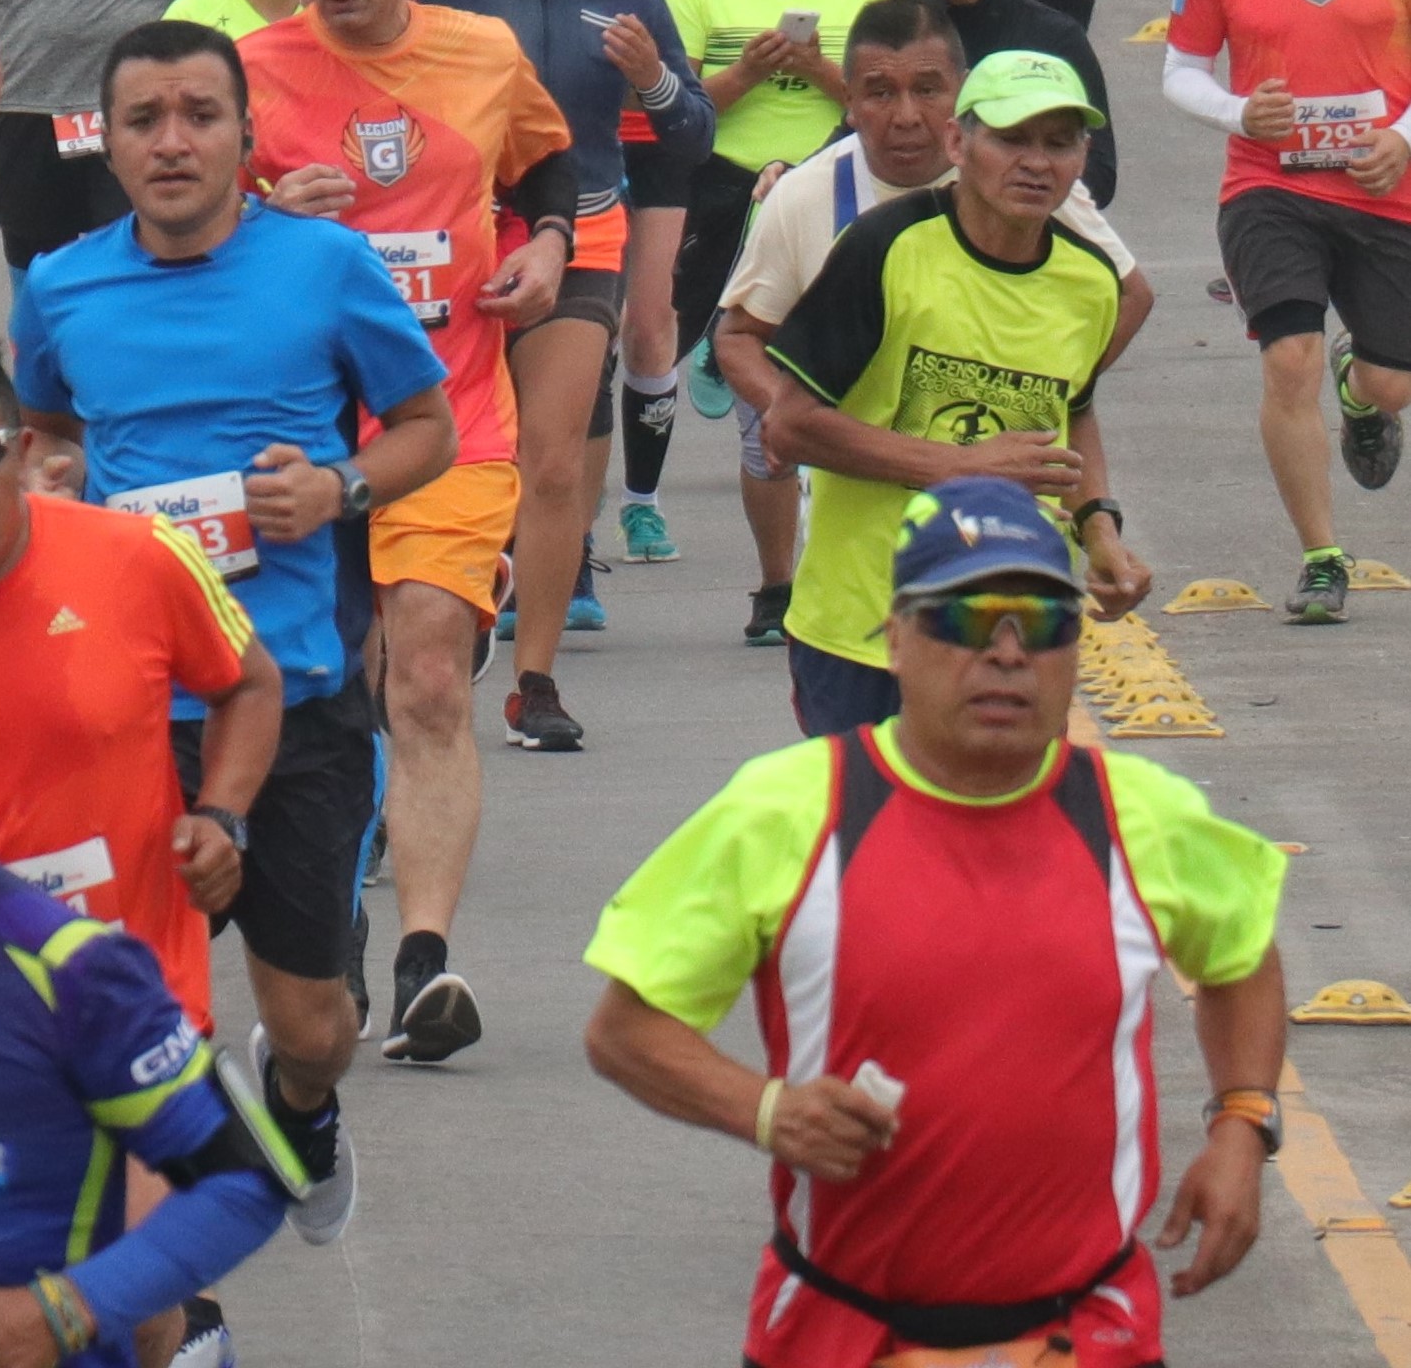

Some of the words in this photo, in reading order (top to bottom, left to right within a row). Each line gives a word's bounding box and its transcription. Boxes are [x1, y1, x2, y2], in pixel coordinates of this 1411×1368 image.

[1323, 105, 1357, 121] Xela
[356, 118, 406, 136] LEGION
[911, 350, 987, 381] ASCENSO
[996, 372, 1016, 389] AL
